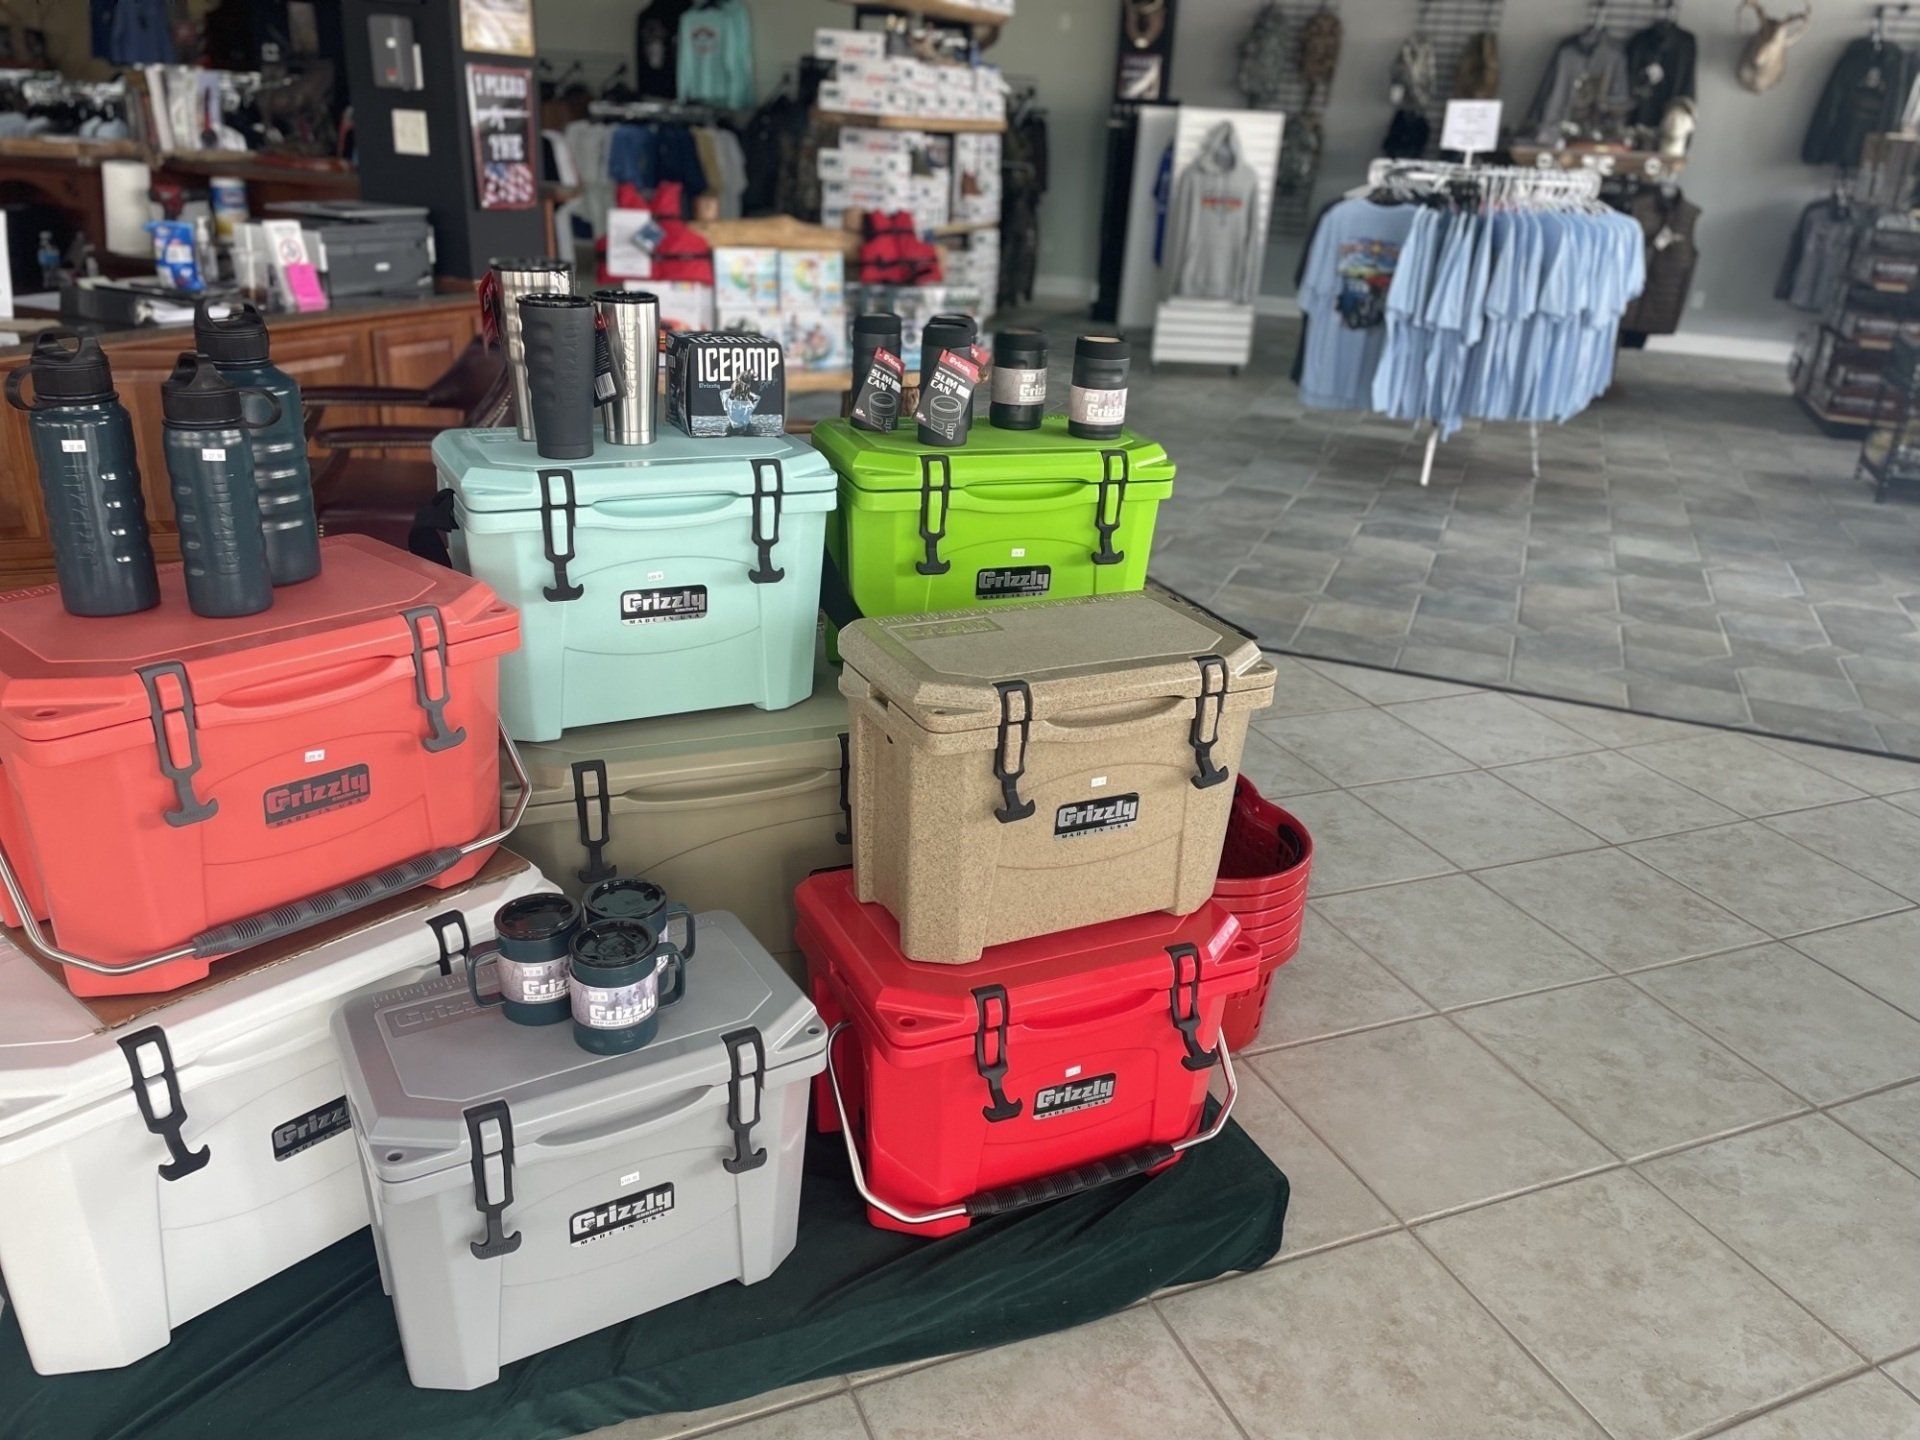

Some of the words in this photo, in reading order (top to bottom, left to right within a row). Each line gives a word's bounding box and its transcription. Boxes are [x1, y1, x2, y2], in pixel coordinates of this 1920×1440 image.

[697, 347, 780, 382] ICEAMP
[871, 368, 893, 386] SLIM
[868, 375, 888, 392] CAN
[930, 379, 952, 395] CAN
[934, 371, 959, 390] SLIM
[979, 571, 1049, 590] Grizzly
[623, 590, 706, 613] Grizzly
[267, 774, 369, 814] Grizzly
[1058, 800, 1138, 828] Grizzly
[589, 993, 656, 1020] Grizzly
[1036, 1081, 1114, 1109] Grizzly
[573, 1191, 672, 1235] Grizzly
[580, 1231, 613, 1246] MADE
[642, 1213, 665, 1224] USA
